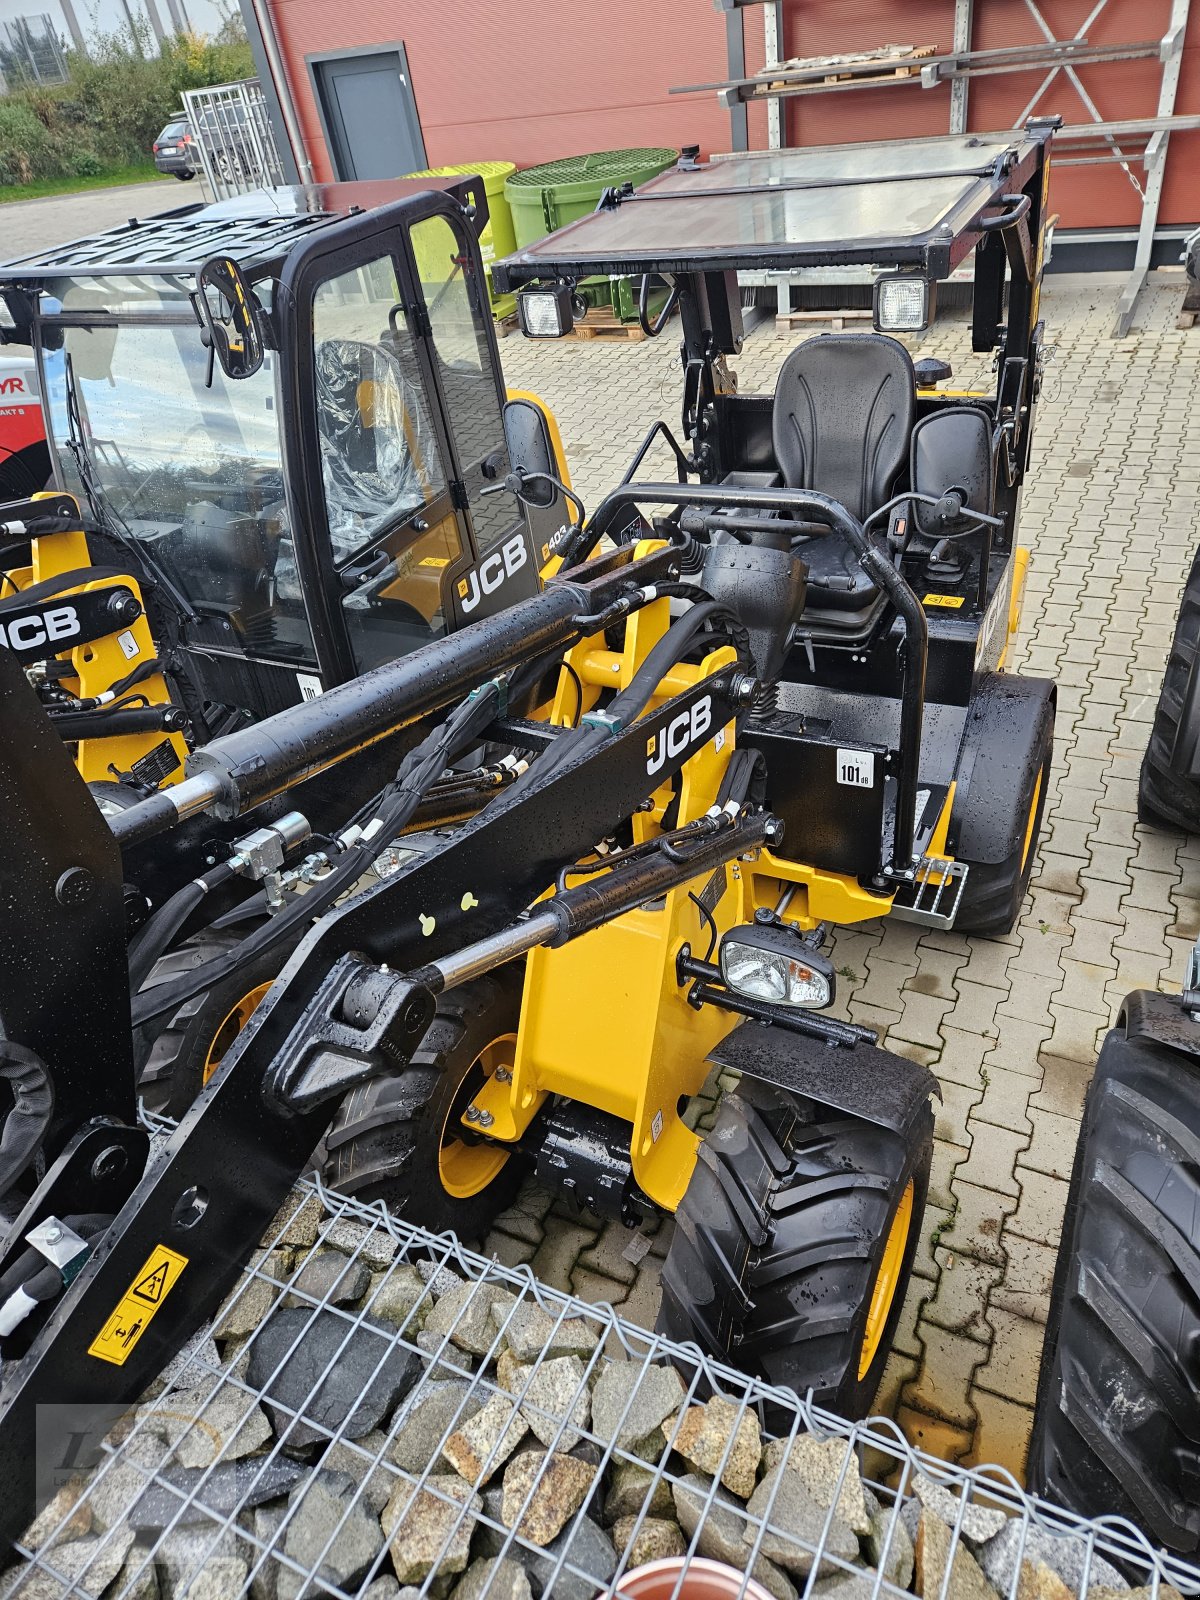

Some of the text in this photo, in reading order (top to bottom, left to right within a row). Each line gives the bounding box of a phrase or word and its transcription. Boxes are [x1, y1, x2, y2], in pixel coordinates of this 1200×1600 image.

[461, 534, 527, 613] JCB
[646, 694, 712, 776] JCB
[841, 764, 869, 785] 101 dB
